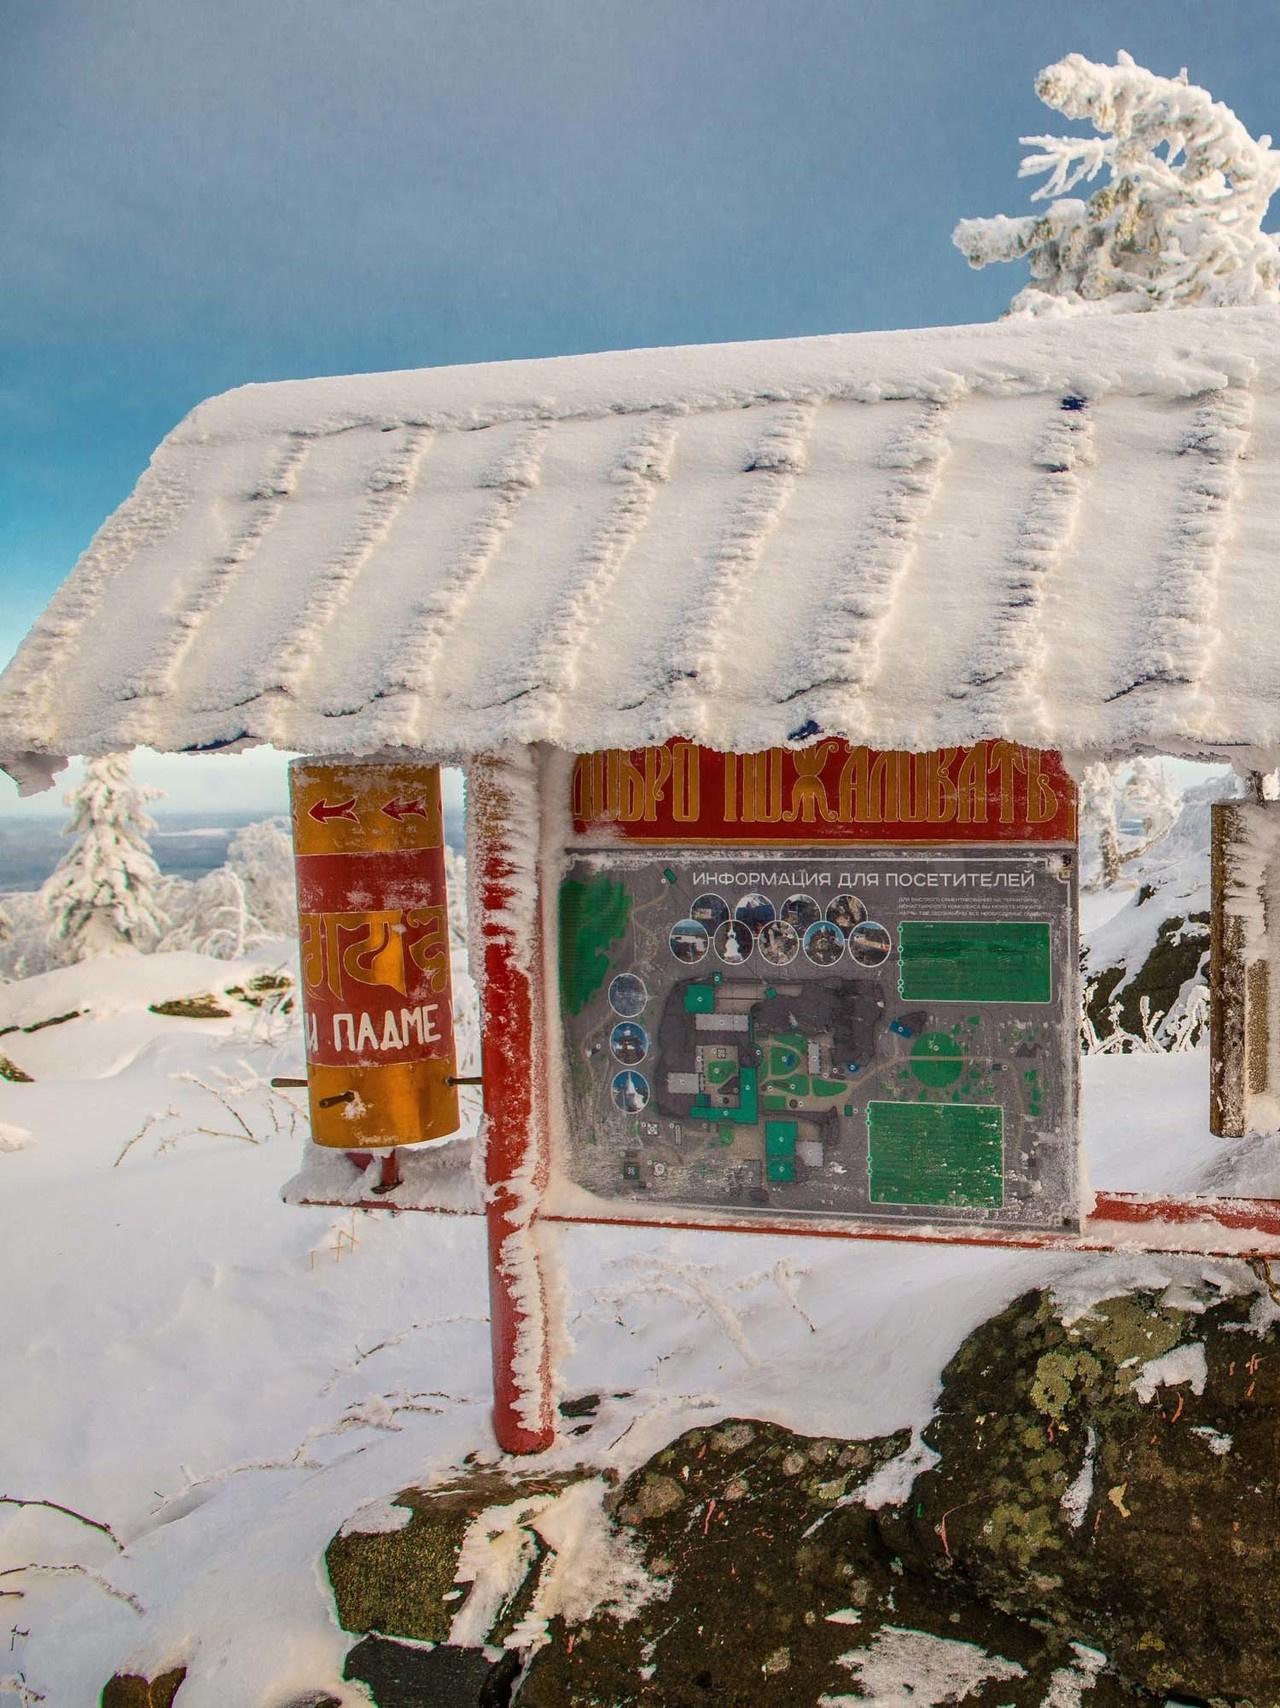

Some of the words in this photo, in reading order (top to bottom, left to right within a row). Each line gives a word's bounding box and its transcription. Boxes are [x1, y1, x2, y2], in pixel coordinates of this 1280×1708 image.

[693, 872, 831, 888] ИНФОРМАЦИЯ
[838, 873, 879, 888] ДЛЯ
[886, 870, 1035, 887] ПОСЕТИТЕЛЕЙ
[333, 1004, 441, 1051] ПАДМЕ
